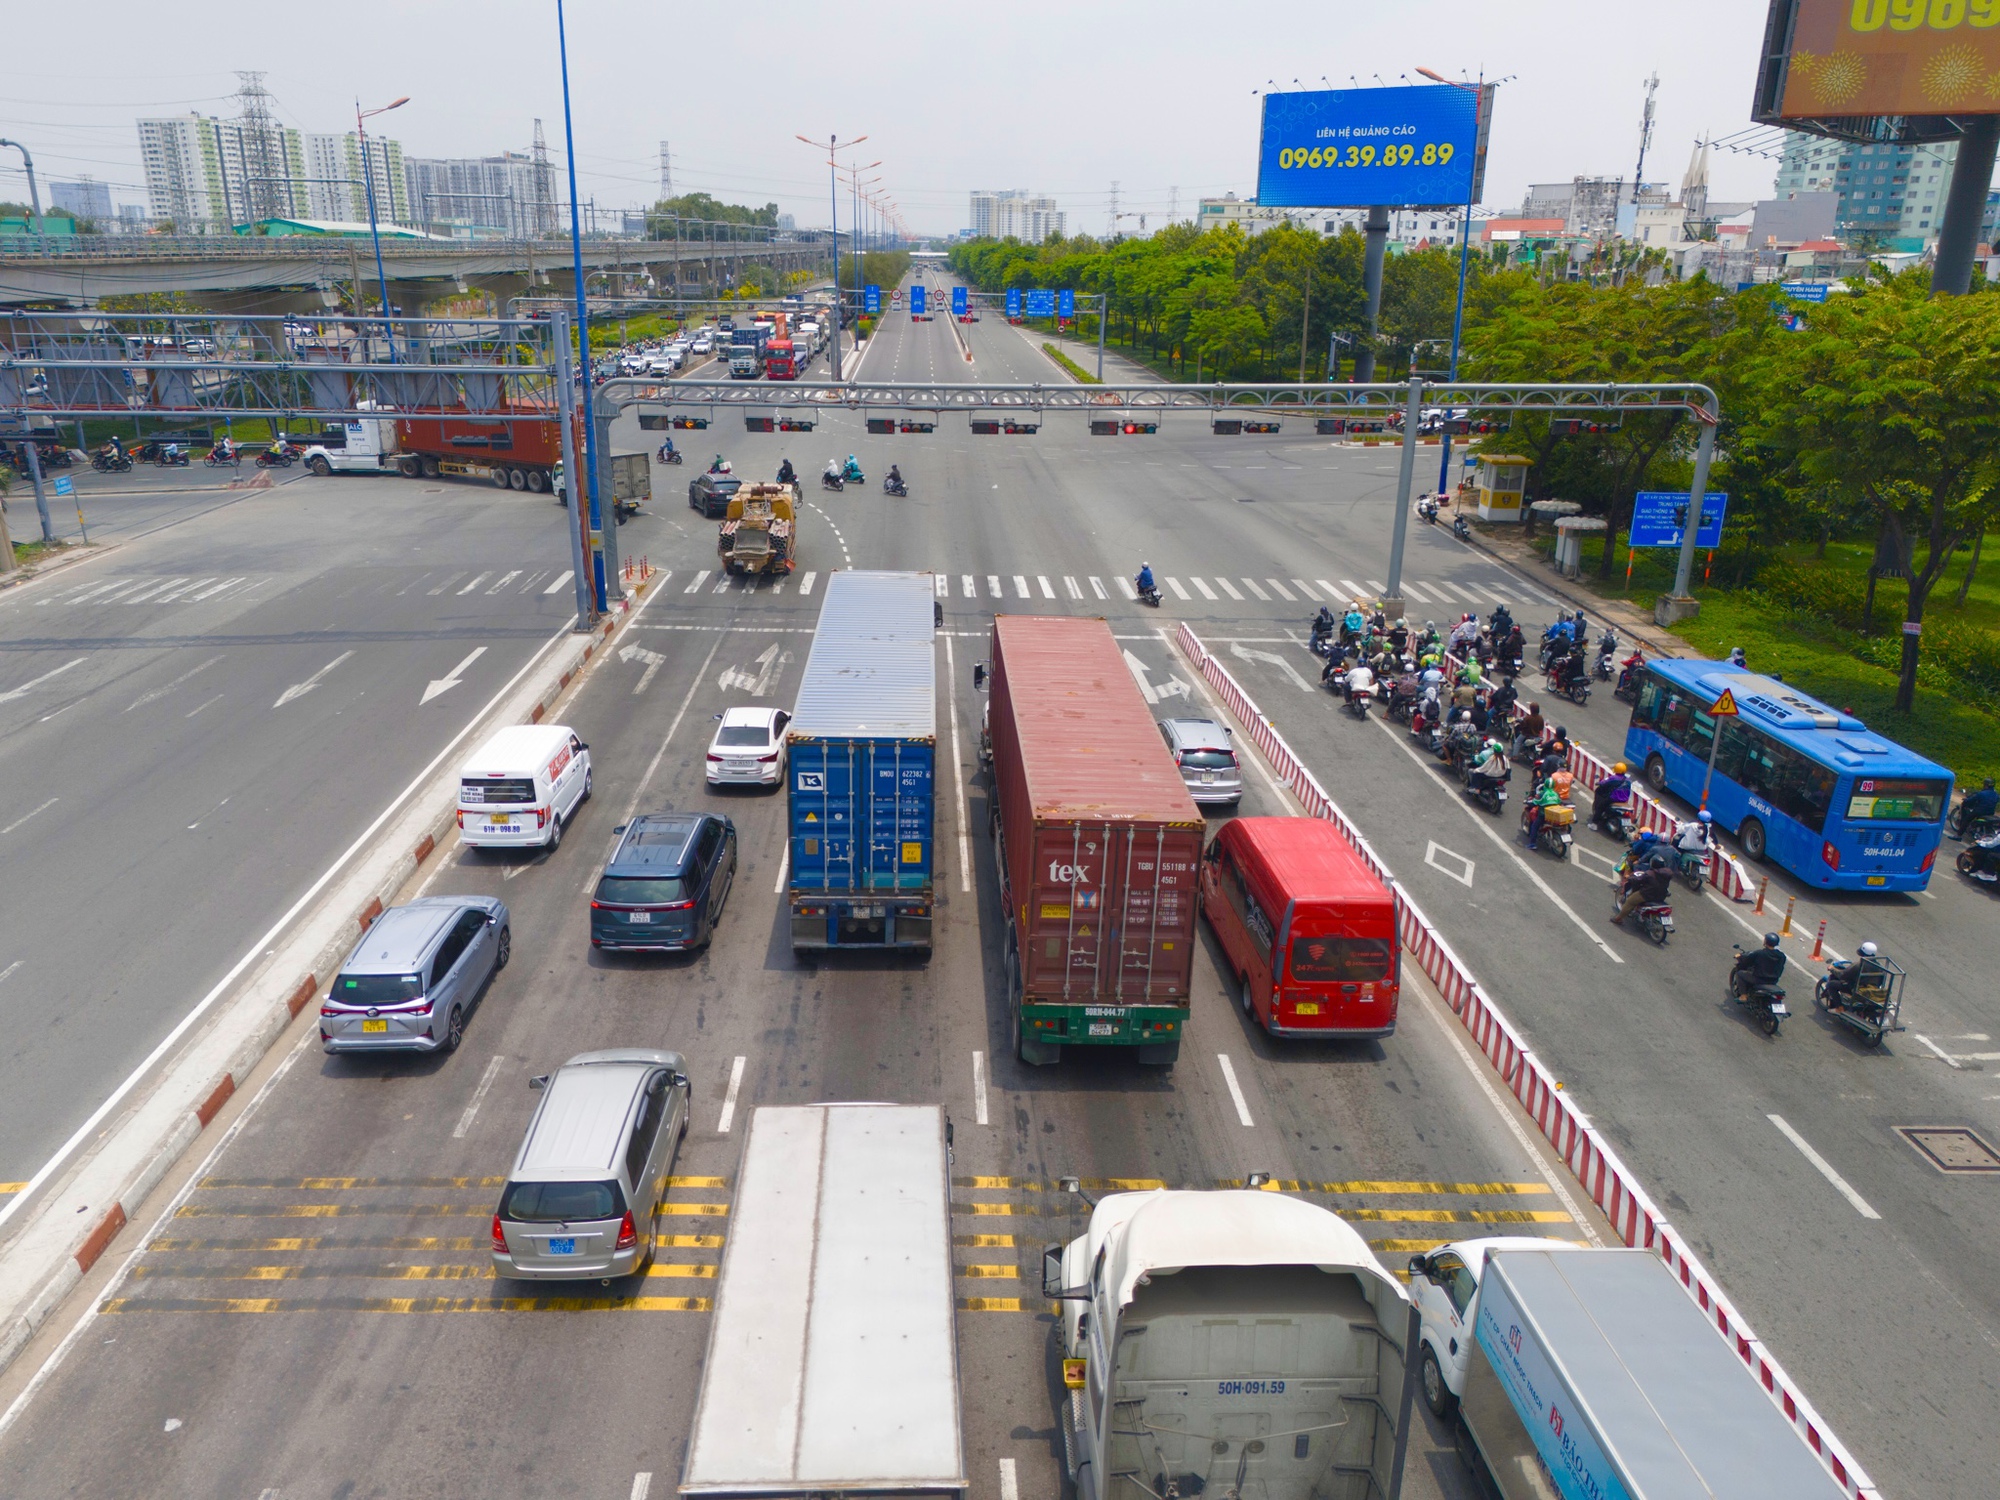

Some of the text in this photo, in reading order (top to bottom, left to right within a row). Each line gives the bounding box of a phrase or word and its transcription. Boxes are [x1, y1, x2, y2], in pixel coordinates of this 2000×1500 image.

[1316, 124, 1416, 139] LIÊN HỆ QUẢNG CÁO
[1279, 143, 1454, 169] 0969.39.89.89
[879, 770, 894, 778] BMOU
[902, 770, 923, 778] 622382
[1861, 782, 1873, 791] 99
[1863, 847, 1905, 857] 50H-401.04
[1049, 859, 1090, 883] tex
[1137, 862, 1154, 871] TGBU
[1162, 862, 1186, 871] 551188
[1161, 875, 1177, 885] 45G1
[1484, 1307, 1493, 1323] CTY
[1562, 1431, 1583, 1472] BẢO
